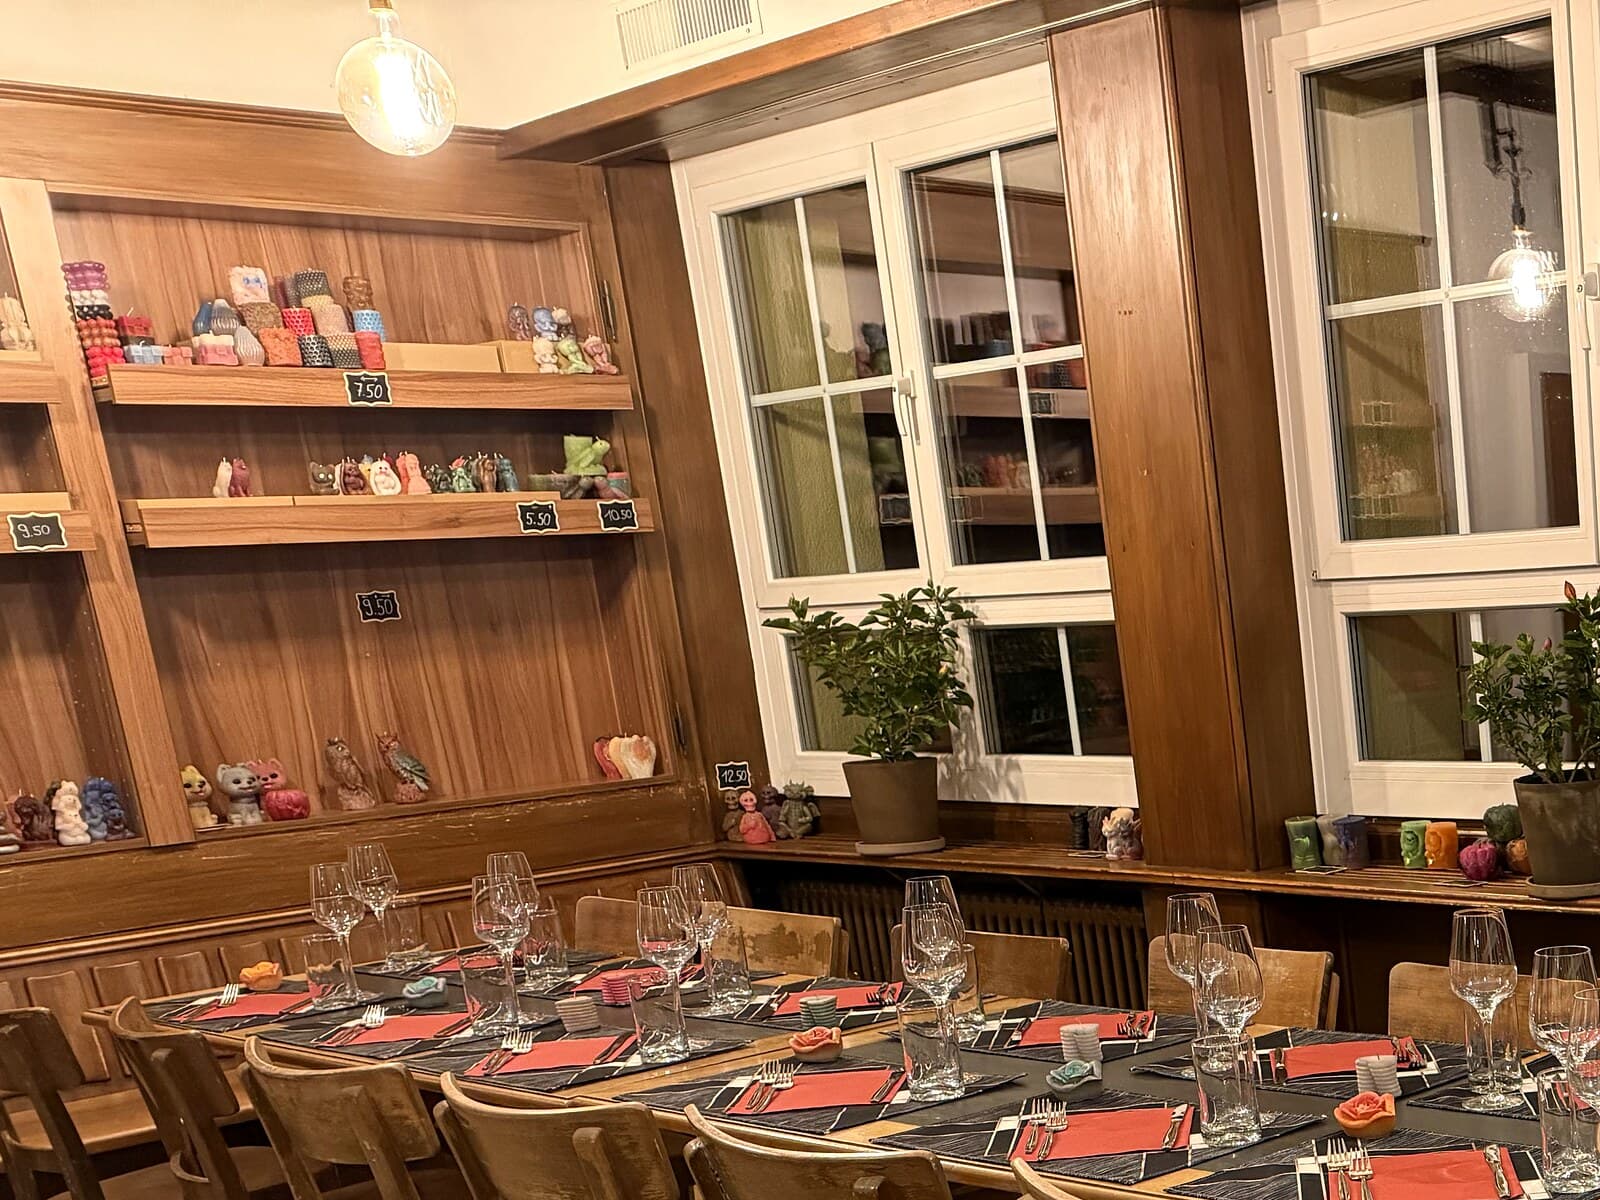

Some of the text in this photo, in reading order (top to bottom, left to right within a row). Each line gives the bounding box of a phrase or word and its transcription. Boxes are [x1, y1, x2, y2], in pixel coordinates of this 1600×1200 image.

[354, 382, 383, 399] 7.50
[526, 512, 551, 526] 5.50
[17, 523, 51, 539] 9.50
[362, 598, 393, 616] 9.50
